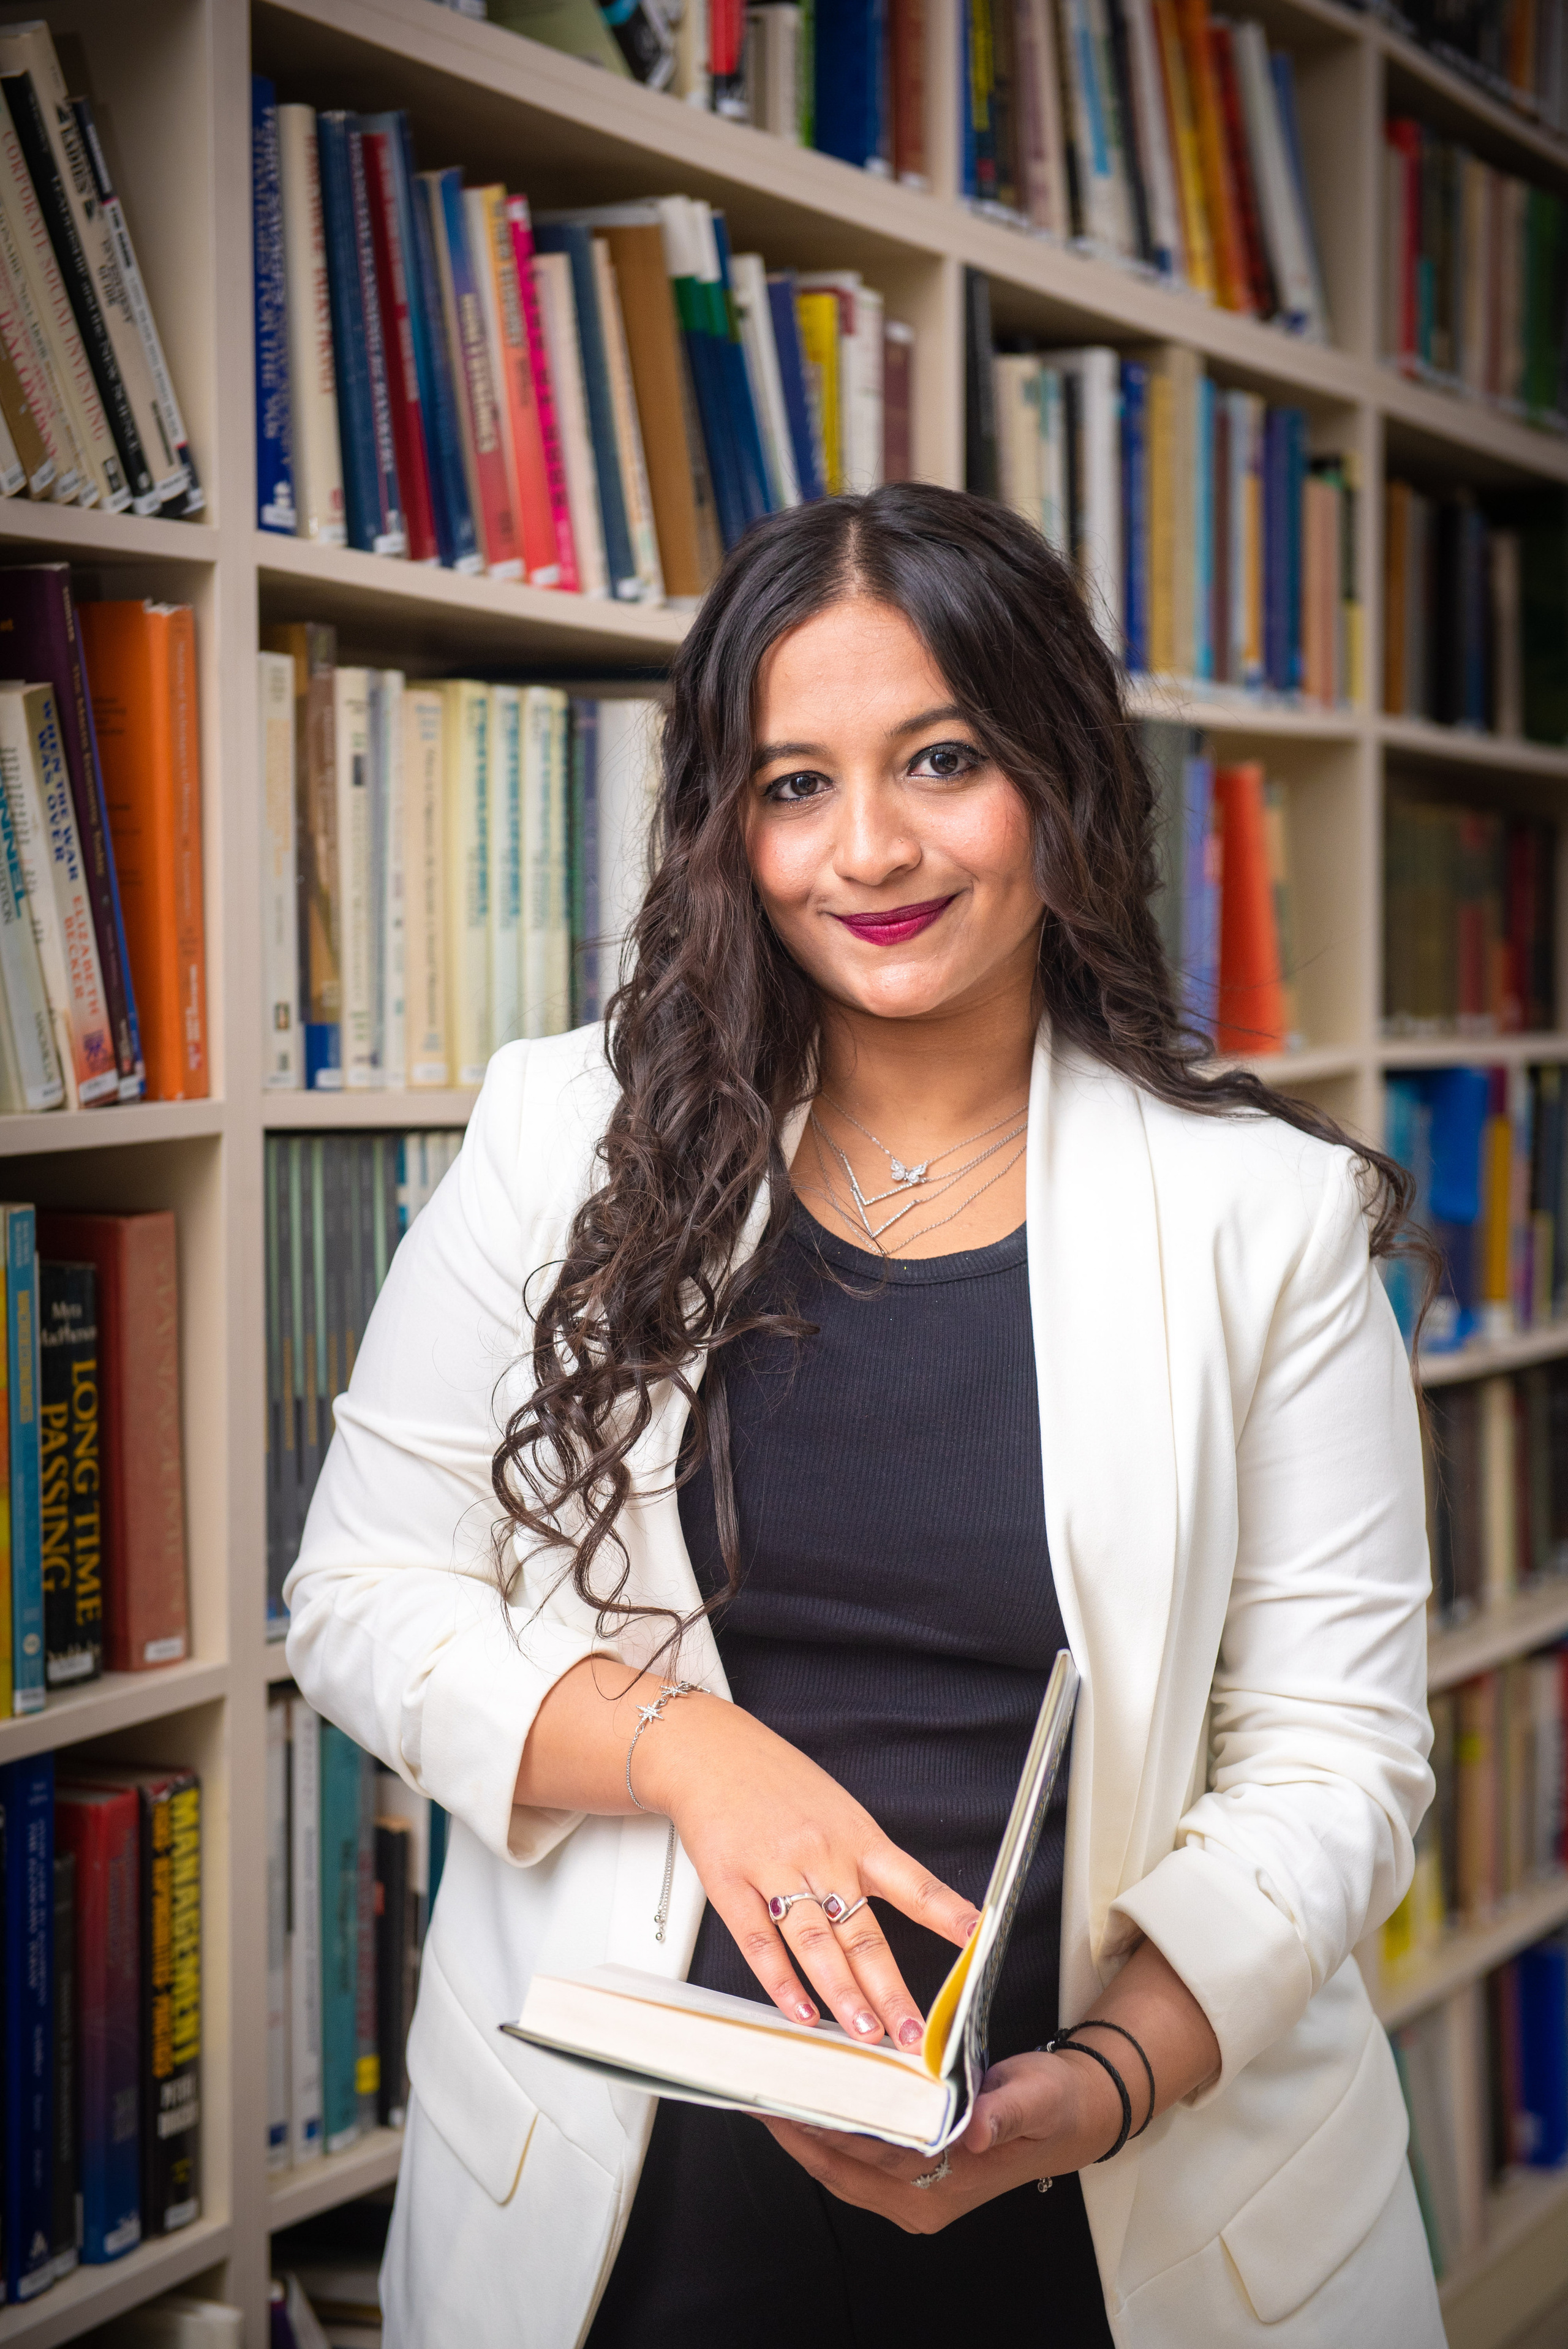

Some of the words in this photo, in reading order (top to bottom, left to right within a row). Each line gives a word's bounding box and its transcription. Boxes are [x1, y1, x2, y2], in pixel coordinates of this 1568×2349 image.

[1, 129, 51, 252] CORPORATE
[39, 255, 74, 331] SOCIAL
[64, 333, 109, 441] INVESTING
[42, 698, 62, 772] WHEN
[36, 730, 54, 785] WAS
[46, 793, 66, 863] OVER
[55, 779, 69, 822] THE
[61, 824, 78, 882] WAR
[62, 915, 84, 999] BECKER
[72, 895, 99, 1014] ELIZABETH
[71, 1358, 100, 1495] LONG
[40, 1402, 72, 1592] PASSING
[74, 1501, 102, 1627] TIME
